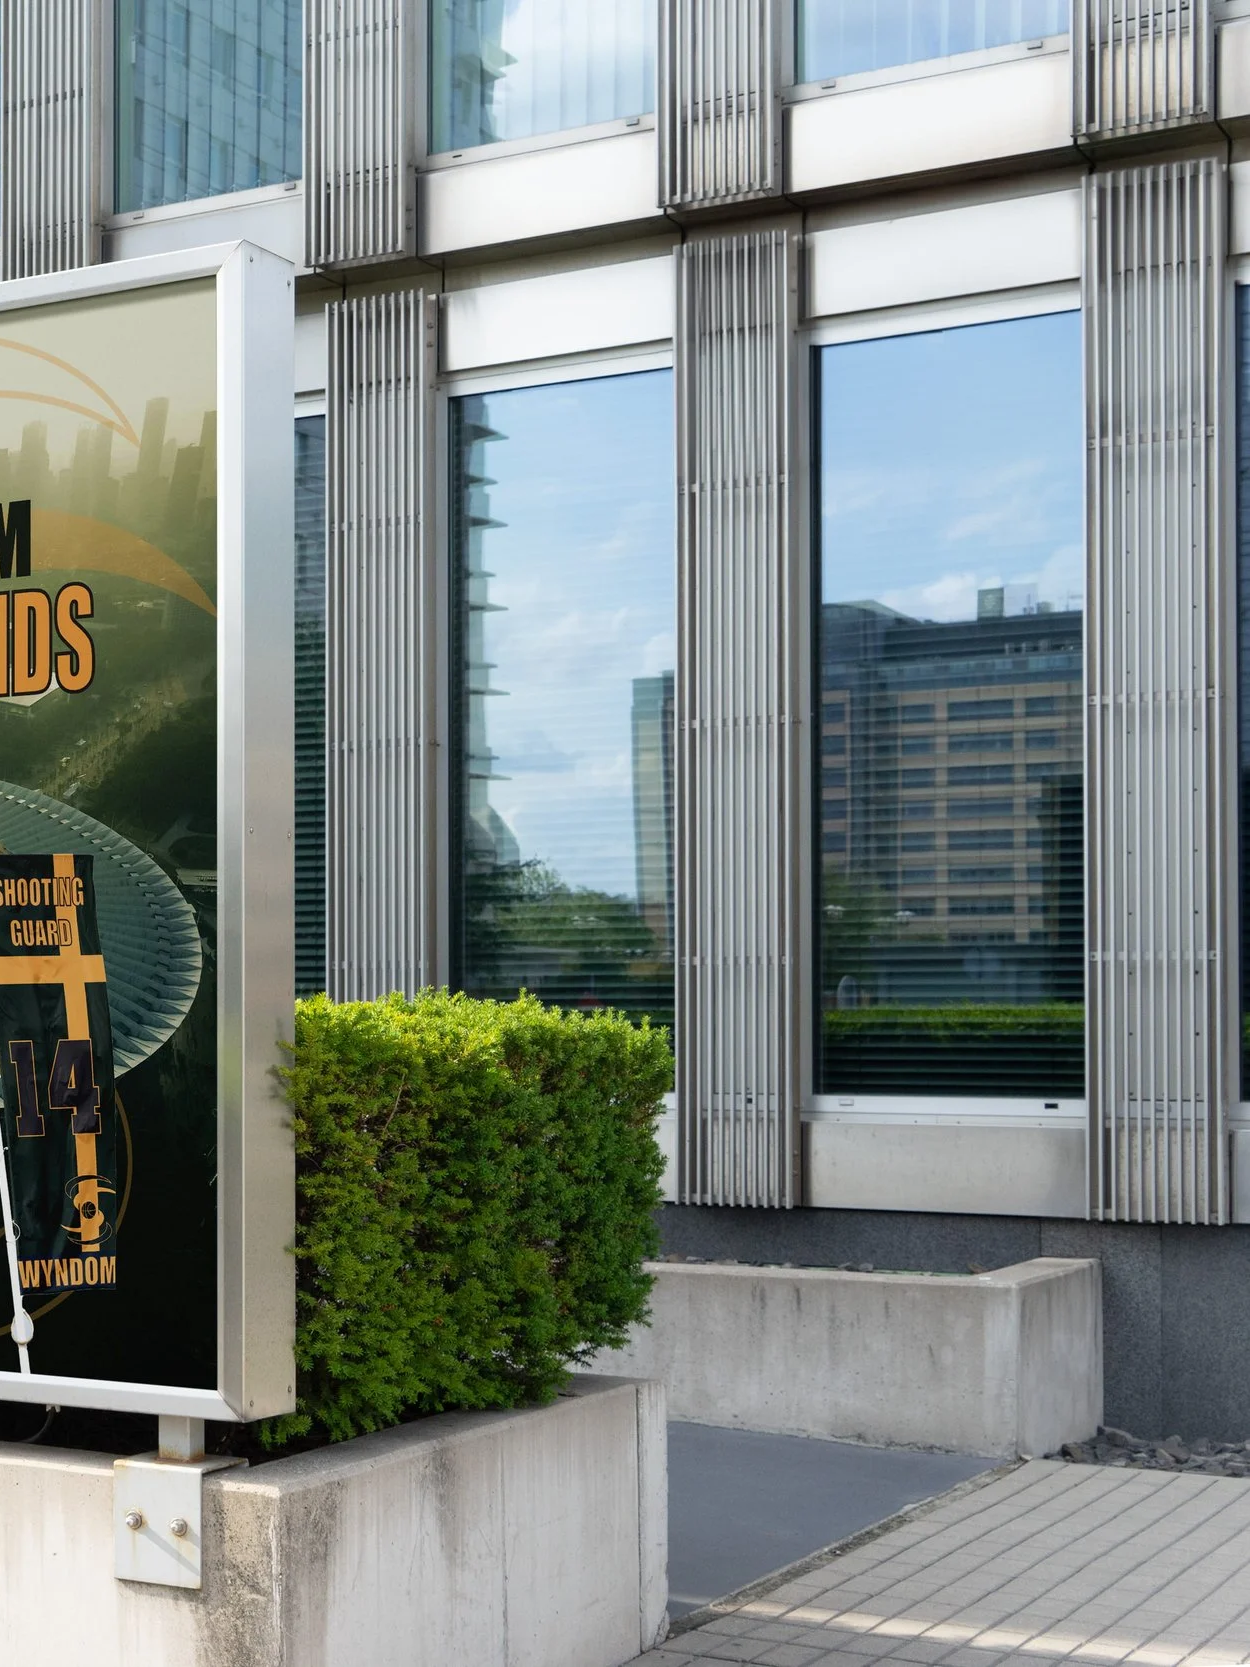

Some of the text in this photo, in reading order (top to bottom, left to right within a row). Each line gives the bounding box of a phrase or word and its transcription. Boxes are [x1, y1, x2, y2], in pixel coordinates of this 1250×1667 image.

[10, 918, 73, 947] GUARD
[8, 1038, 102, 1138] 14
[19, 1256, 116, 1289] WYNDOM
